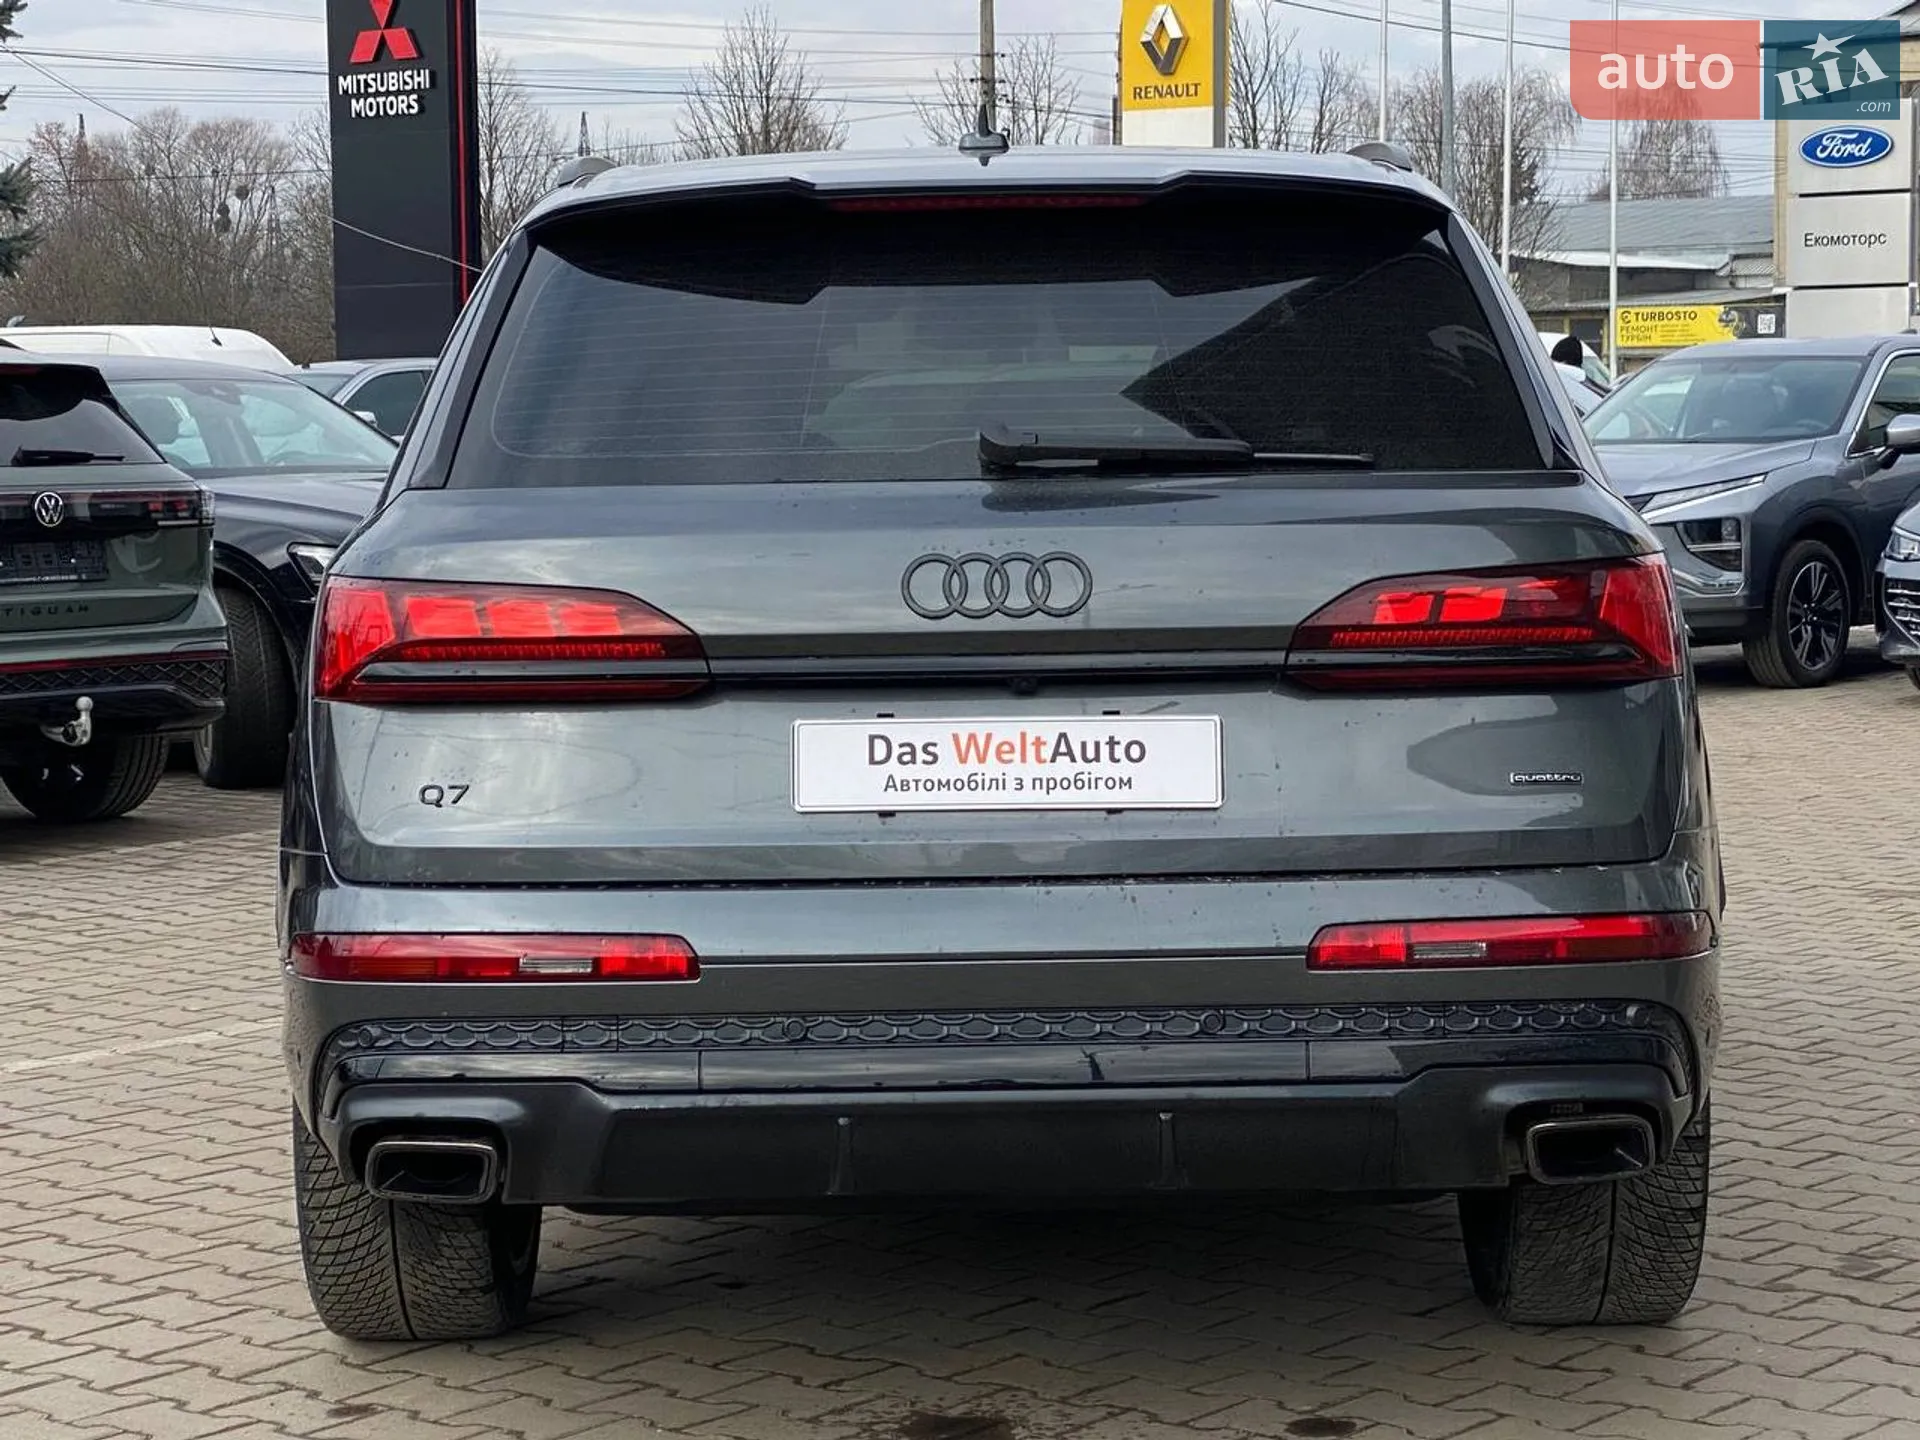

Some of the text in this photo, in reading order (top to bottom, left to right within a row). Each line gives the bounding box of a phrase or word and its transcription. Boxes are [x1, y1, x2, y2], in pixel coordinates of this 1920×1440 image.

[338, 68, 430, 95] MITSUBISHI
[1132, 83, 1201, 101] RENAULT
[351, 94, 419, 118] MOTORS
[1816, 132, 1874, 159] Ford
[1803, 232, 1888, 248] Екомоторс
[1633, 310, 1698, 322] TURBOSTO
[2, 604, 90, 617] TIGUAN
[867, 731, 1147, 767] Das WeltAuto
[883, 771, 1133, 796] Автомобілі з пробігом
[1514, 773, 1581, 783] quattro
[419, 784, 470, 808] Q7
